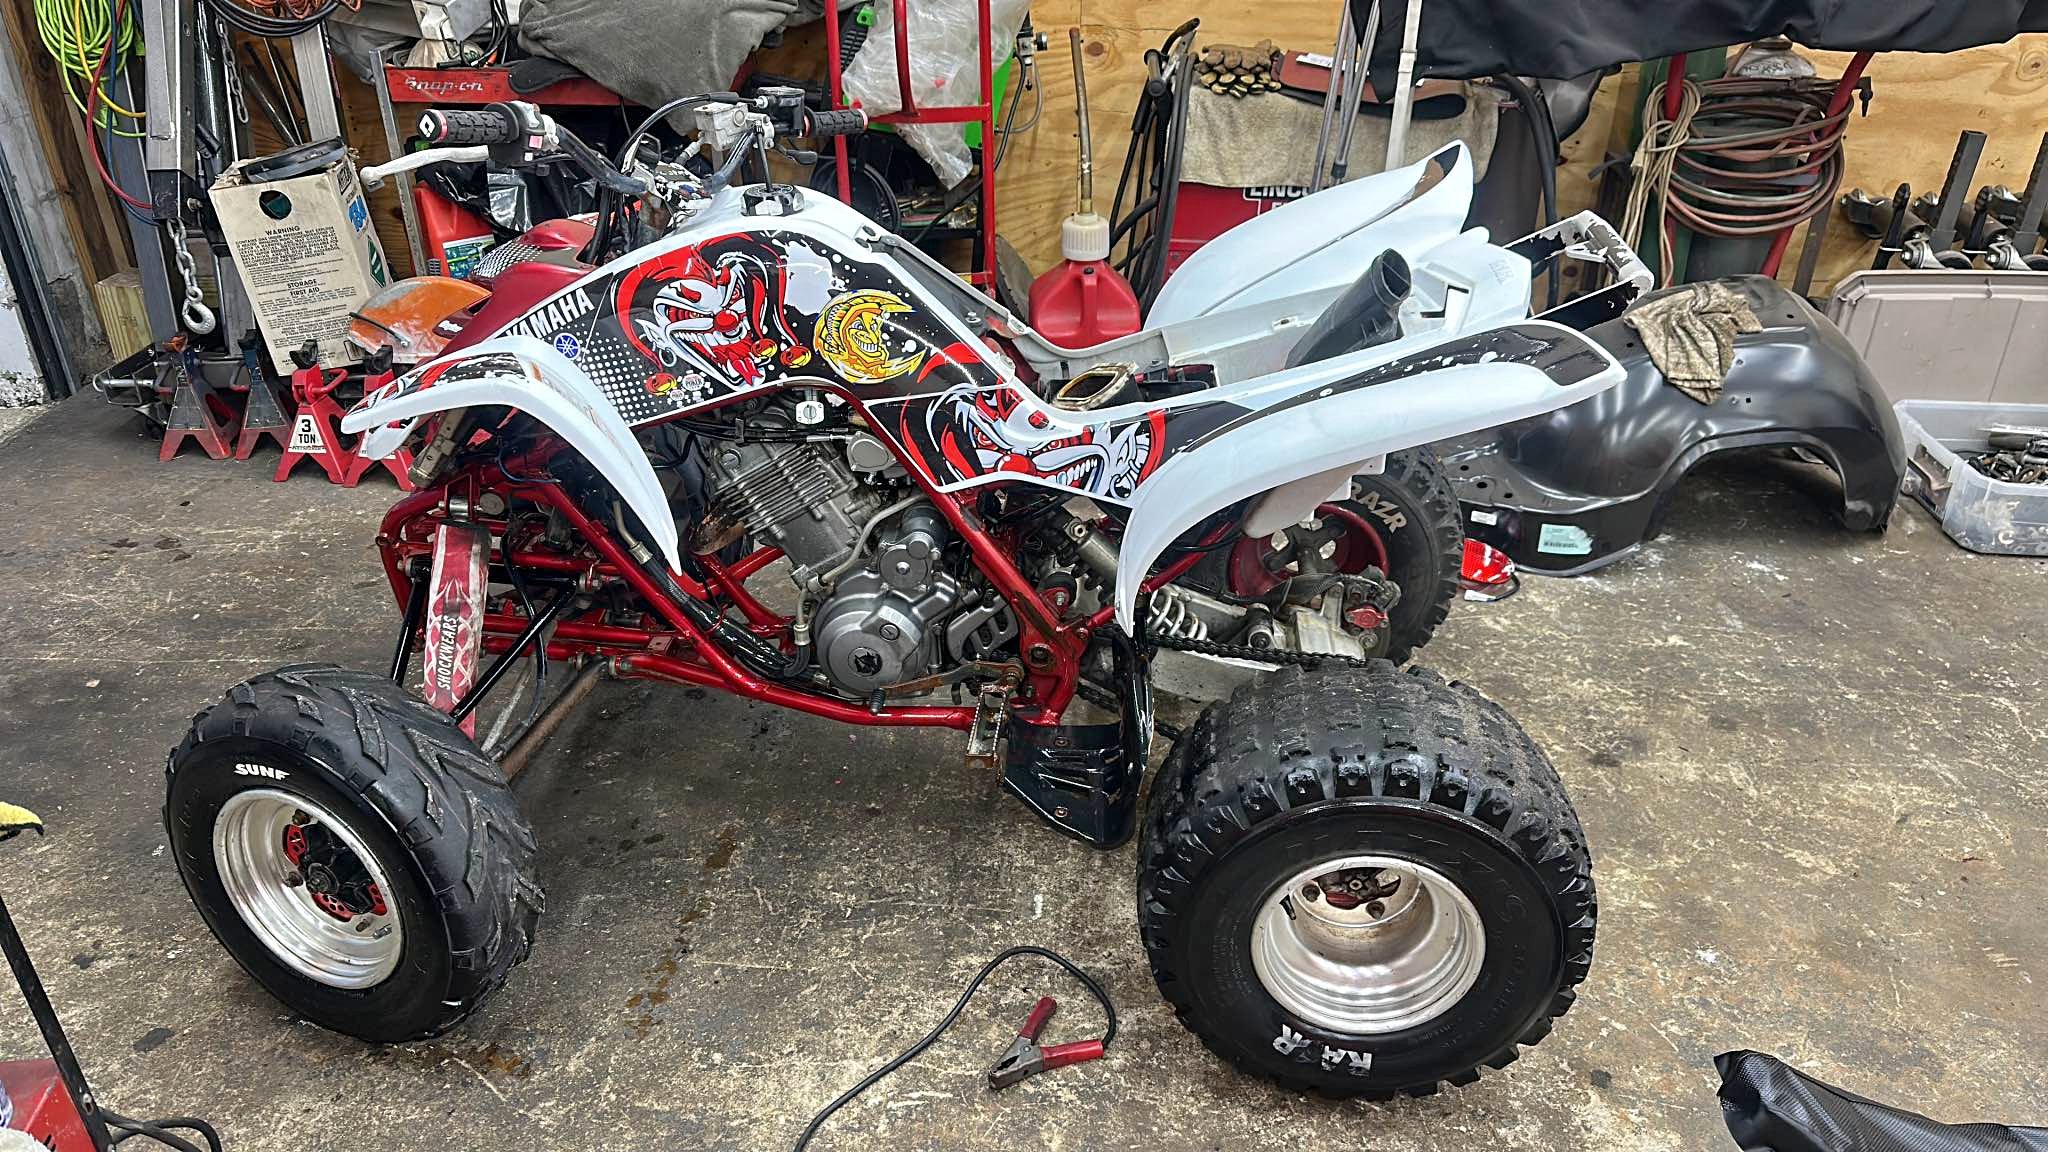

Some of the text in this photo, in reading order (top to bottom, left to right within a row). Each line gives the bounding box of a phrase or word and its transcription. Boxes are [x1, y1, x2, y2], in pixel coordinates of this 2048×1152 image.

[265, 225, 300, 236] WARNING
[287, 279, 317, 289] STORAGE
[301, 419, 312, 433] 3
[298, 433, 316, 444] TON
[1351, 481, 1408, 533] RAZR
[437, 615, 459, 690] SHOCKWEARS
[233, 763, 291, 781] SUNF
[1272, 1023, 1373, 1077] RAR
